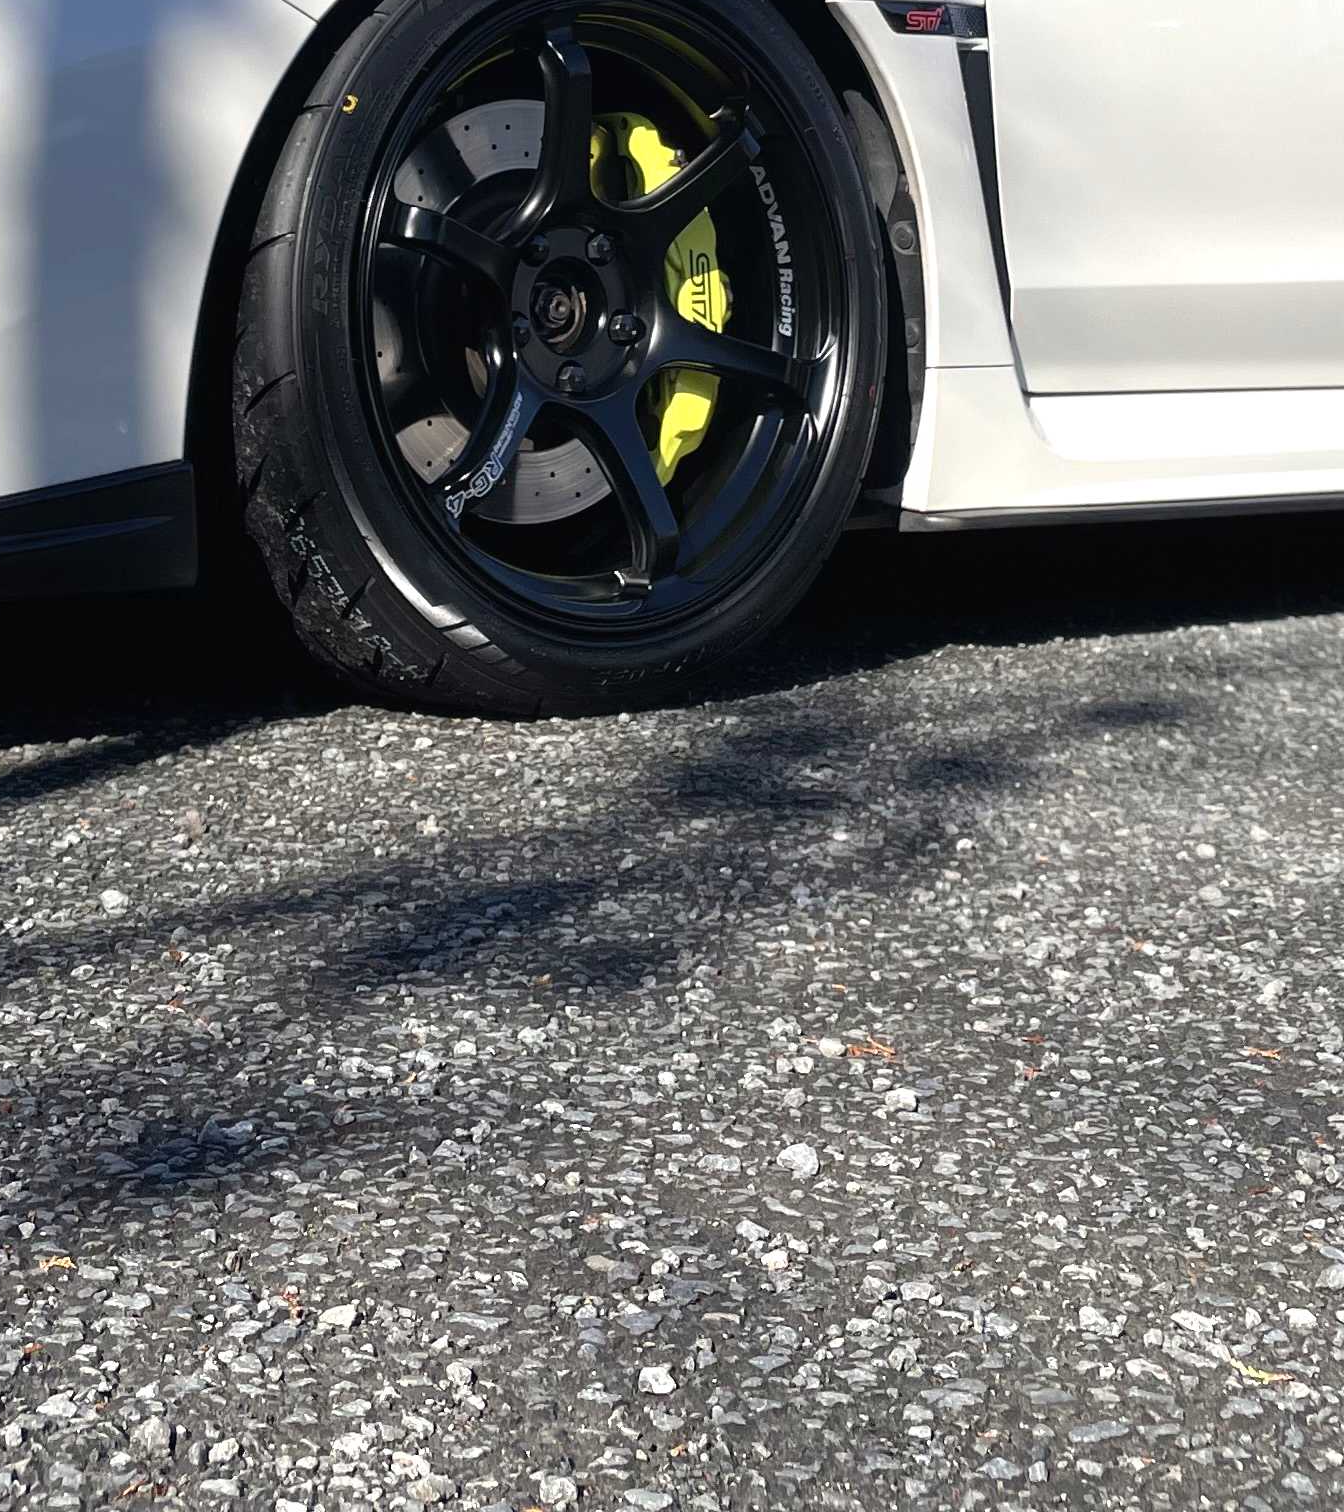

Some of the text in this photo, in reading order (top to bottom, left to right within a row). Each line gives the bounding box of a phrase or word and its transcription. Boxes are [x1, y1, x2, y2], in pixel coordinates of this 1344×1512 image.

[906, 5, 945, 32] STI
[749, 165, 796, 338] ADVAN Racing
[445, 452, 504, 519] RG-4
